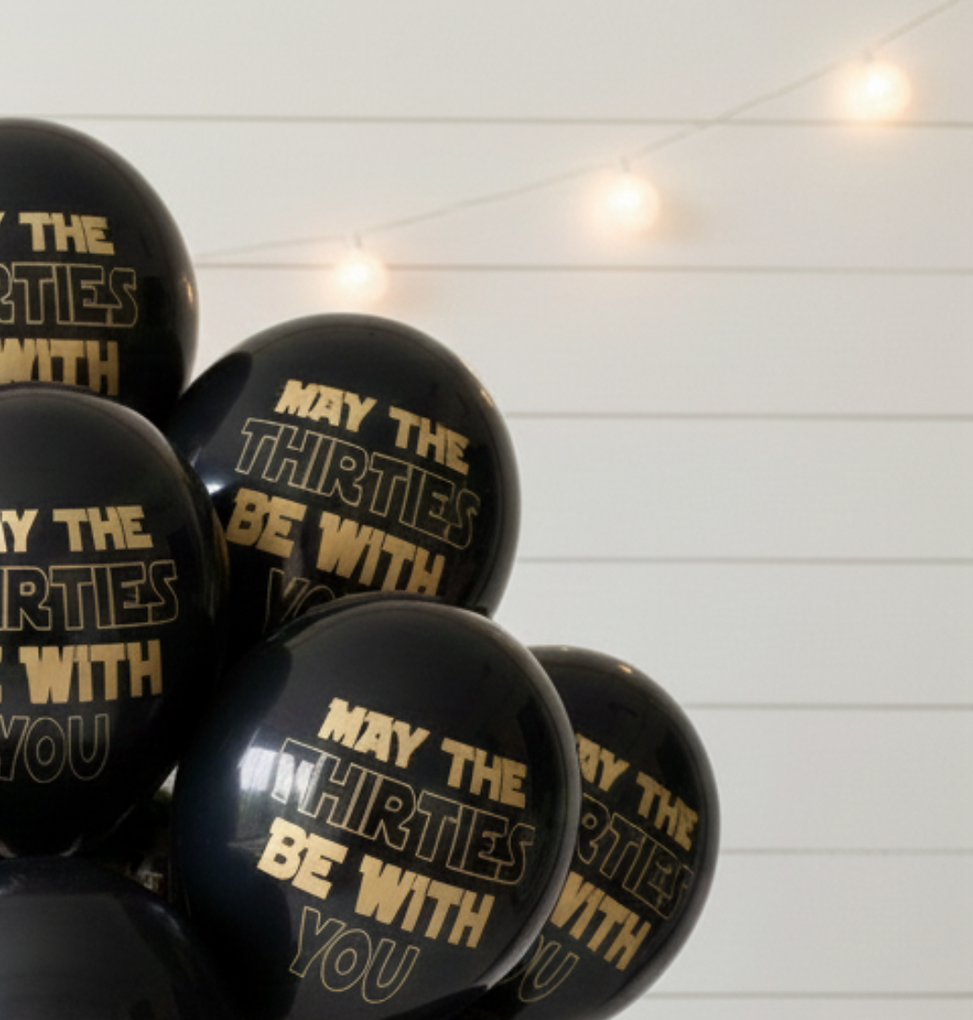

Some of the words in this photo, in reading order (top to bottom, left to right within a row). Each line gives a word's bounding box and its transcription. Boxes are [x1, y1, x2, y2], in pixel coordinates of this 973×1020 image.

[19, 212, 115, 255] THE
[275, 379, 377, 433] MAY
[389, 406, 470, 476] THE
[52, 505, 153, 552] THE
[235, 417, 481, 549] THIRTIES
[226, 488, 307, 558] BE
[316, 511, 446, 596] WITH
[19, 639, 162, 704] WITH
[318, 697, 430, 769] MAY
[441, 737, 527, 809] THE
[576, 733, 630, 792] AY
[636, 771, 698, 851] THE
[271, 738, 535, 885] THIRTIES
[257, 816, 349, 900] BE
[354, 854, 495, 948] WITH
[289, 906, 420, 1004] YOU
